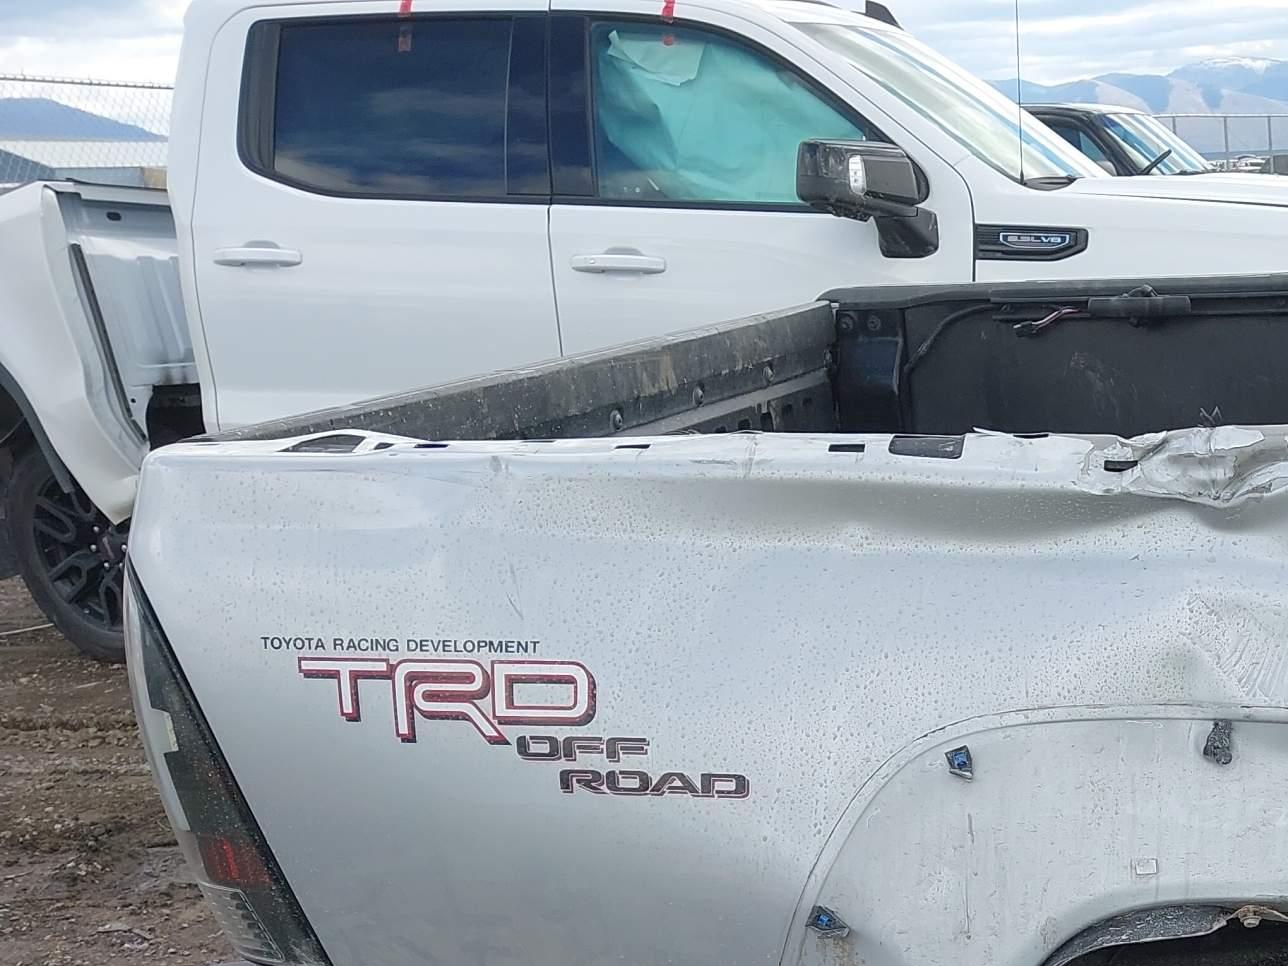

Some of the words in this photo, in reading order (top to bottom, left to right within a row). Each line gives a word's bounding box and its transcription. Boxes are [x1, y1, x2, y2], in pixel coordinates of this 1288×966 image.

[260, 636, 326, 652] TOYOTA
[332, 637, 399, 653] RACING
[406, 639, 540, 655] DEVELOPMENT
[297, 656, 598, 745] TRD
[515, 734, 651, 763] OFF
[558, 768, 750, 799] ROAD
